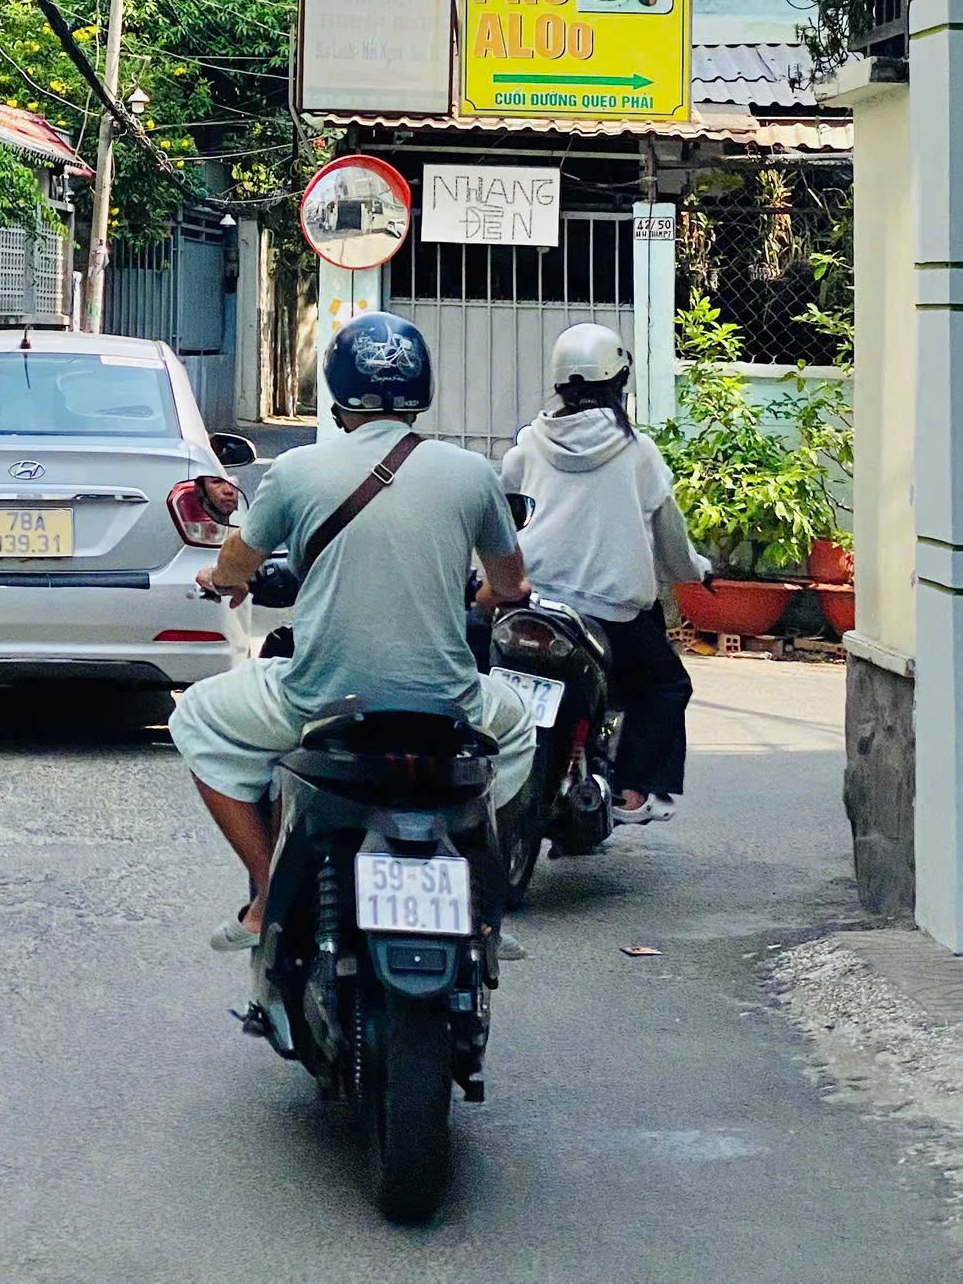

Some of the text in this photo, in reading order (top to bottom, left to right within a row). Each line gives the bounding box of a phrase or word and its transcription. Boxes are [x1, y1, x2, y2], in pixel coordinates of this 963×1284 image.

[432, 175, 555, 210] NHANG
[6, 511, 46, 532] 78A
[368, 894, 460, 930] 118.11
